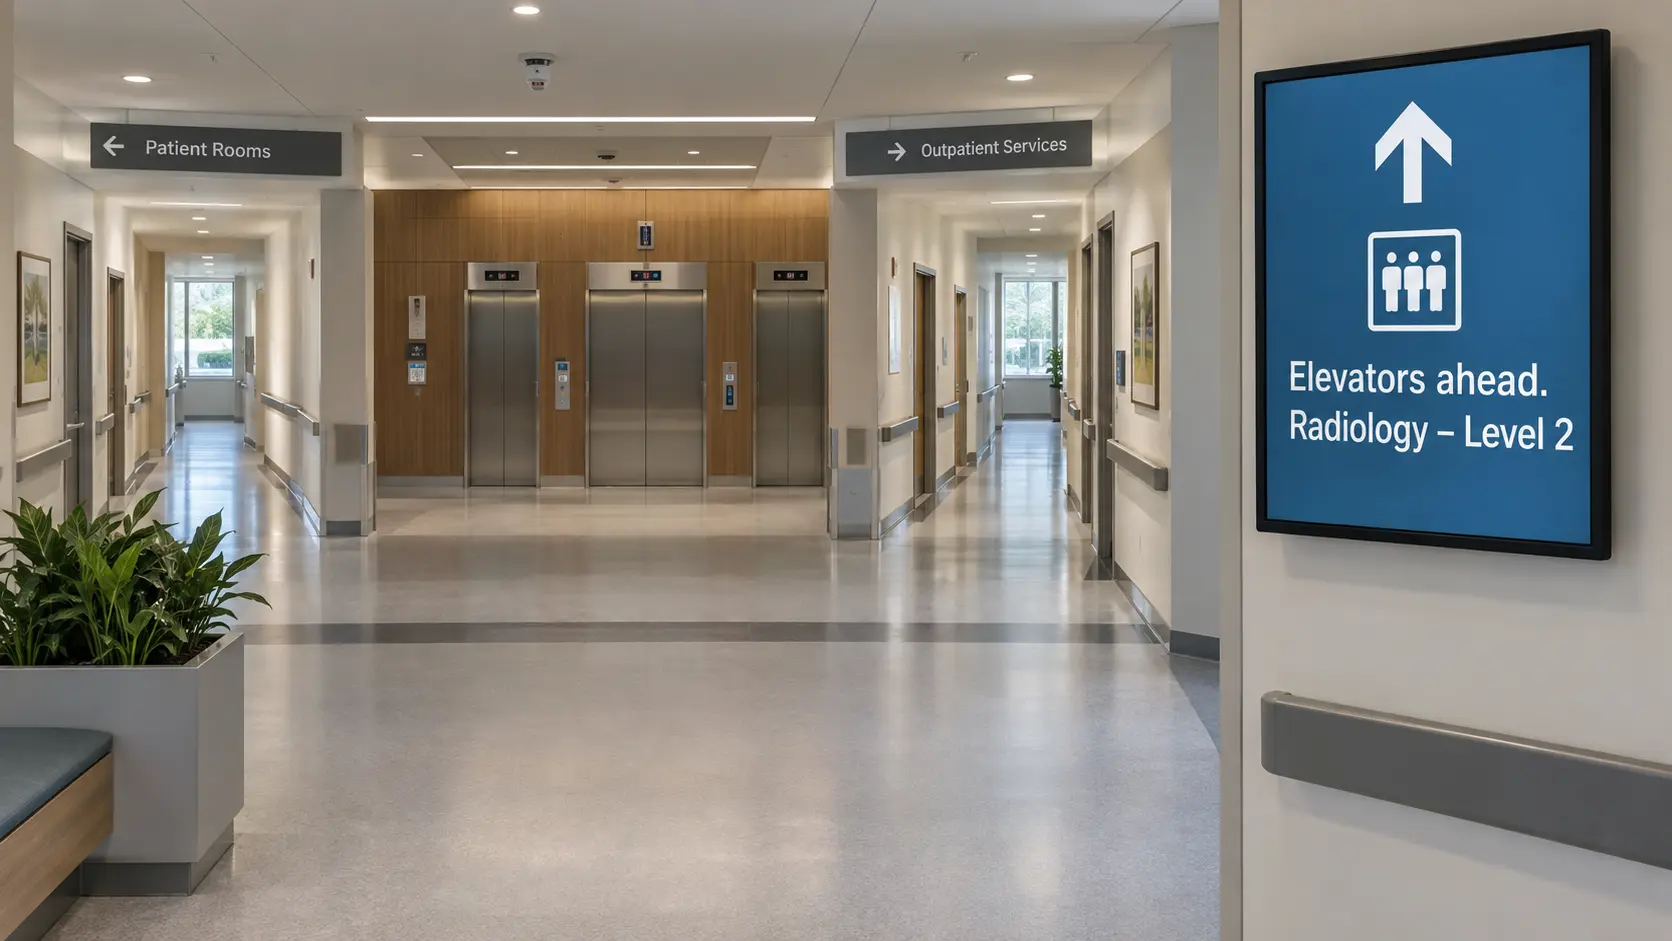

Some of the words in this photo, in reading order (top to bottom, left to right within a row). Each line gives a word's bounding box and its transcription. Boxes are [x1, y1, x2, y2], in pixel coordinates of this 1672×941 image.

[146, 139, 208, 157] Patient
[212, 142, 272, 160] Rooms
[921, 140, 1000, 160] Outpatient
[1003, 137, 1068, 155] Services
[1290, 360, 1426, 395] Elevators
[1436, 361, 1548, 397] ahead.
[1290, 409, 1429, 454] Radiology
[1465, 414, 1544, 450] Level
[1554, 417, 1574, 451] 2
